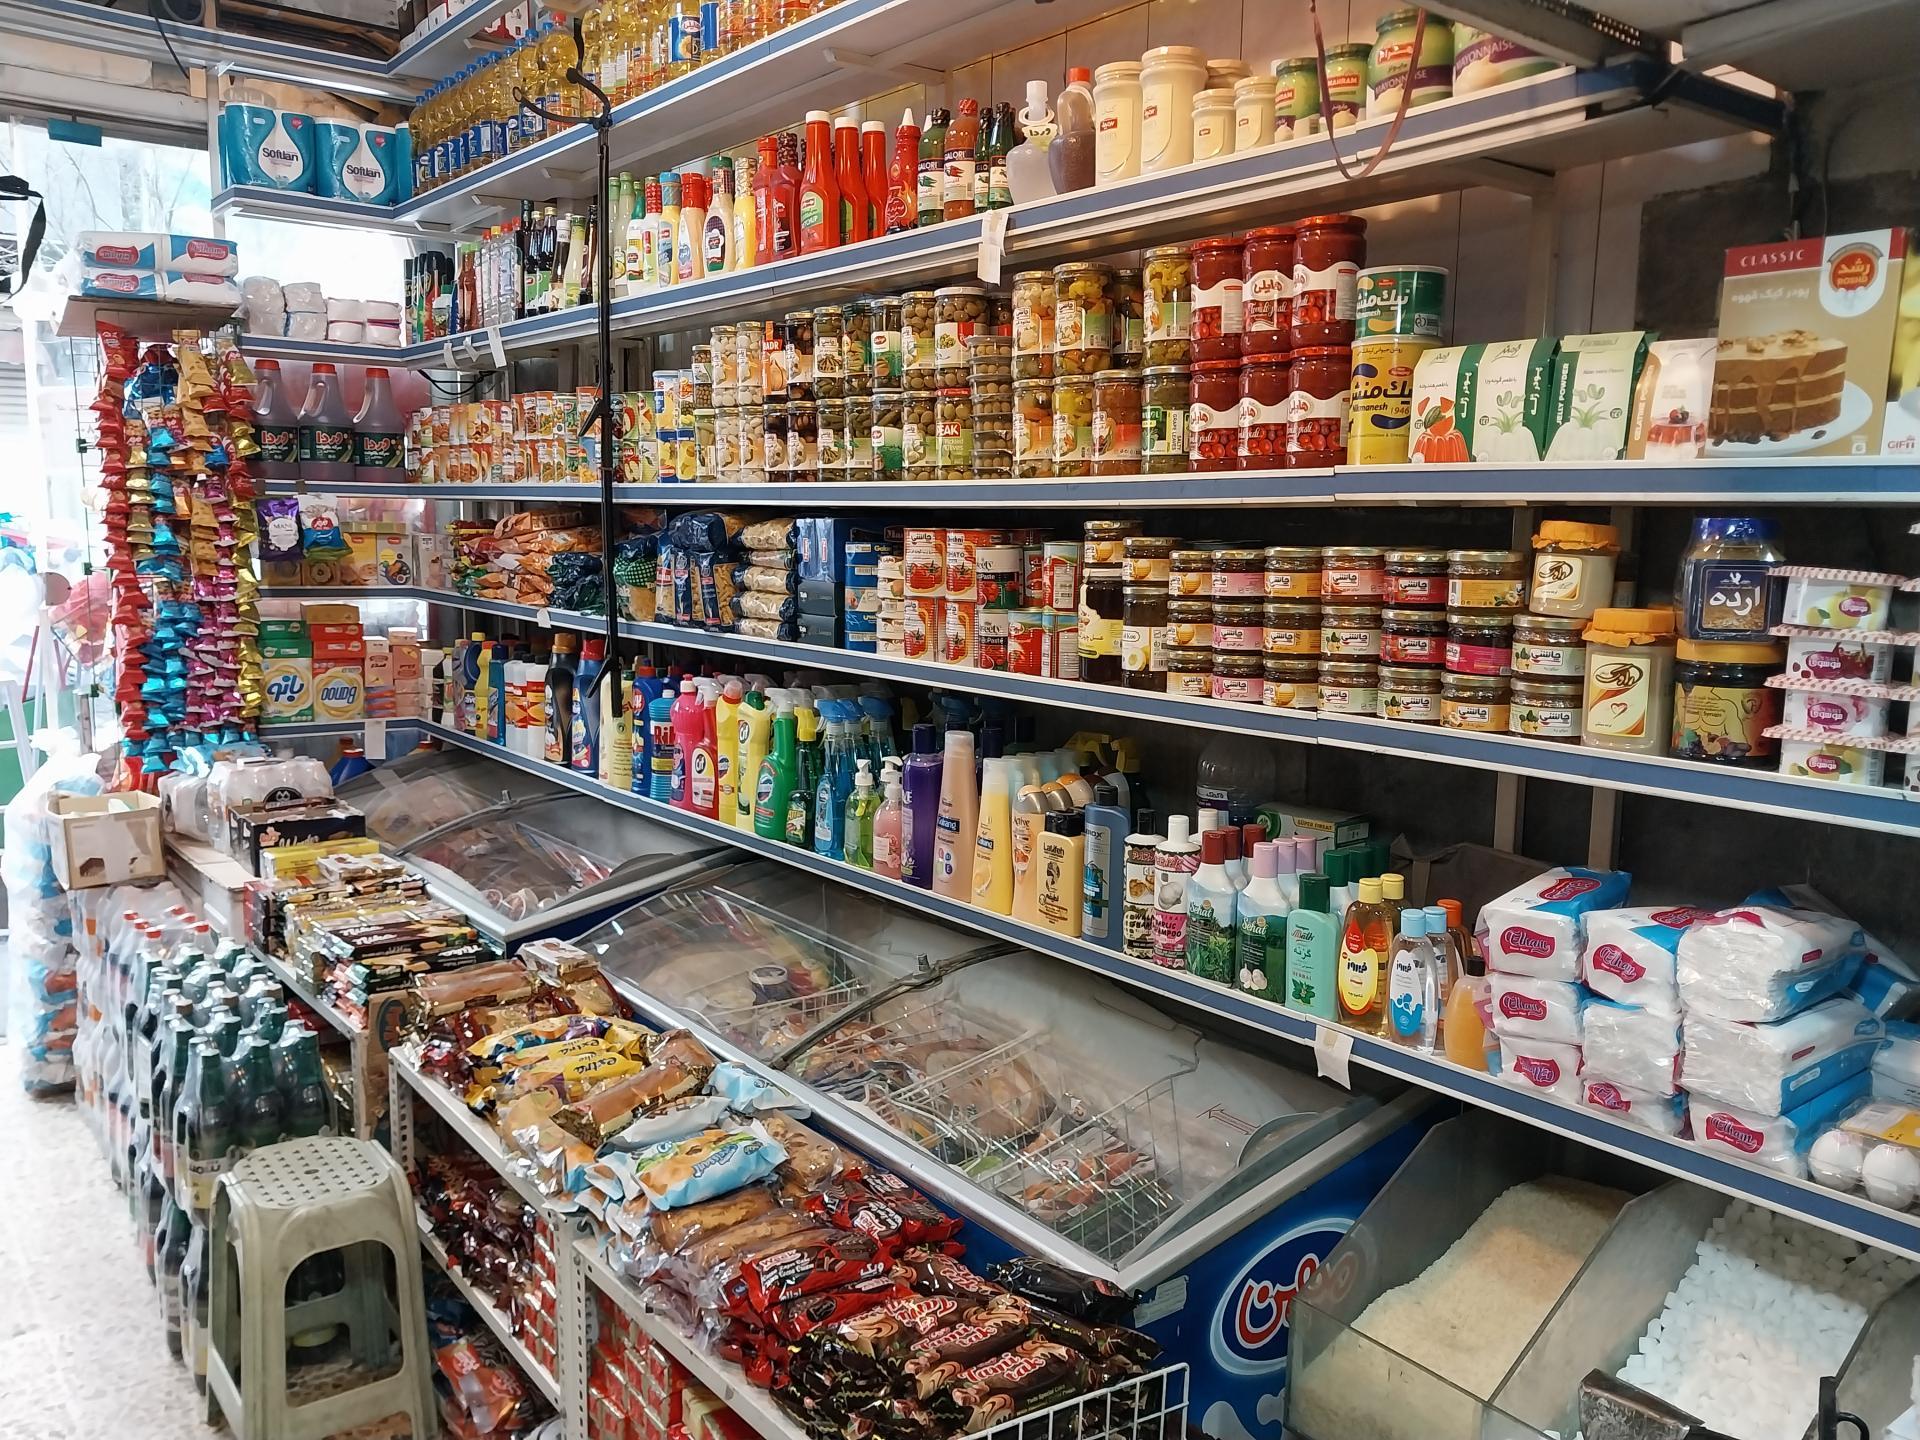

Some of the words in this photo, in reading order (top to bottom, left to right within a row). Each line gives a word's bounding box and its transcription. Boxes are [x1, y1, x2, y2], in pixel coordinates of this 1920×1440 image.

[1375, 69, 1427, 92] MAYONNISE
[262, 147, 299, 162] Softlan
[346, 164, 381, 179] Softlan
[1739, 249, 1805, 268] CLASSIC
[1838, 258, 1870, 277] رشد
[1253, 278, 1282, 293] هایلی
[1558, 362, 1570, 395] POWDER
[1556, 394, 1566, 425] JELLY
[261, 430, 289, 445] وردا
[315, 430, 343, 445] وردا
[363, 437, 391, 450] وردا
[1269, 576, 1290, 585] چاشنی
[1332, 573, 1358, 584] چاشنی
[1400, 579, 1428, 590] چاشنی
[1709, 586, 1761, 616] ارده
[1841, 604, 1869, 613] موسوی
[1221, 630, 1243, 639] چاشنی
[1271, 633, 1293, 643] چاشنی
[1341, 632, 1368, 643] چاشنی
[1399, 639, 1427, 650] چاشنی
[1531, 650, 1562, 661] چاشنی
[1808, 659, 1842, 669] موسوی
[267, 675, 305, 702] بانو
[1223, 681, 1247, 690] چاشنی
[320, 686, 358, 704] Banoo
[1325, 691, 1348, 701] چاشنی
[1401, 698, 1430, 708] چاشنی
[1458, 707, 1487, 718] چاشنی
[1539, 713, 1570, 724] چاشنی
[1809, 710, 1844, 720] موسوی
[1808, 760, 1837, 771] موسوی
[1189, 901, 1214, 918] Sehat
[1241, 916, 1268, 935] Sehat
[1504, 930, 1550, 953] Elham
[1347, 958, 1368, 974] فیروز
[1396, 960, 1412, 973] فیروز
[1600, 945, 1637, 980] Elham
[1502, 994, 1543, 1016] Elham
[573, 1057, 617, 1075] extra
[1710, 1113, 1757, 1150] Elham
[860, 1262, 885, 1279] ویک
[911, 1323, 974, 1351] Tami
[956, 1325, 998, 1347] tak
[957, 1352, 1022, 1382] Tami
[1003, 1356, 1046, 1382] tak
